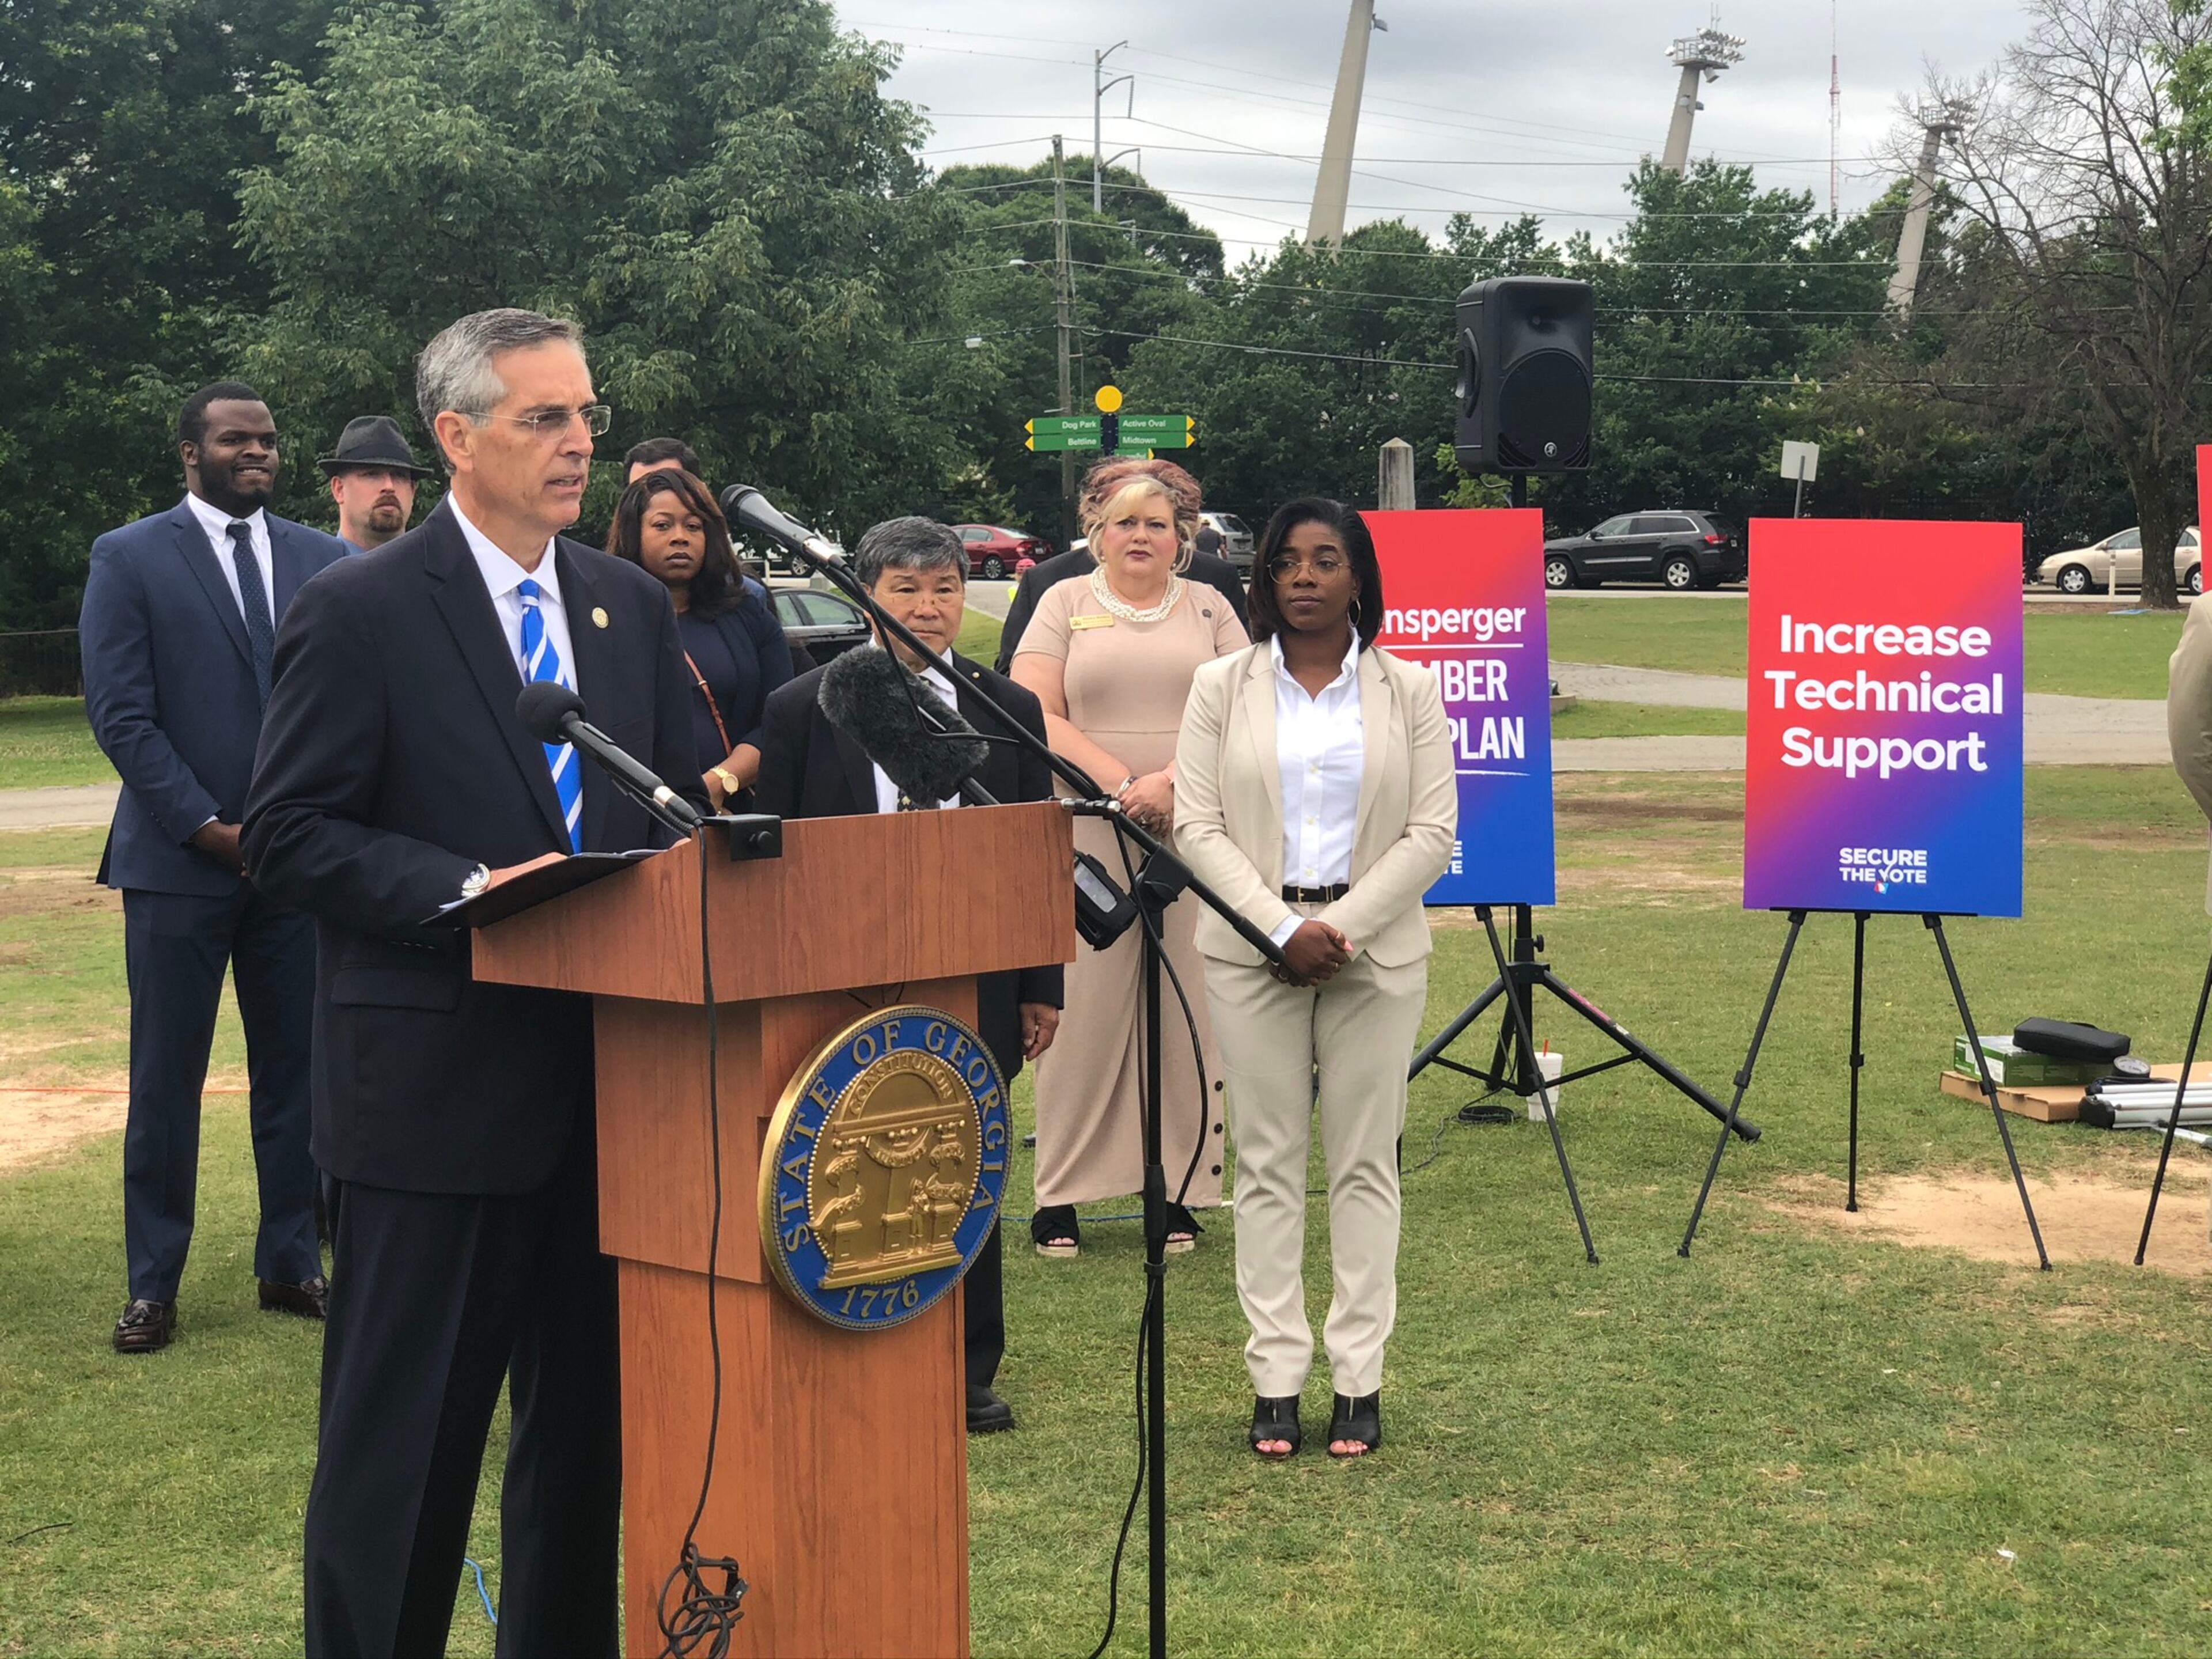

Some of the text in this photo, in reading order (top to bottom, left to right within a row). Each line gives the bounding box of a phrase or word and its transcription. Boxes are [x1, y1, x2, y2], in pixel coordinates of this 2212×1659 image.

[1062, 421, 1097, 430] Dog Park
[1068, 438, 1097, 446] Beltline
[1379, 607, 1527, 642] nsperger
[1781, 615, 1992, 657] Increase
[1764, 670, 2003, 714] Technical
[1781, 726, 1988, 779] Support
[1839, 847, 1927, 866] SECURE
[1839, 865, 1927, 884] THE VOTE
[850, 1052, 953, 1115] CONSTITUTION
[778, 1019, 1006, 1253] STATE OF GEORGIA
[839, 1279, 919, 1319] 1776
